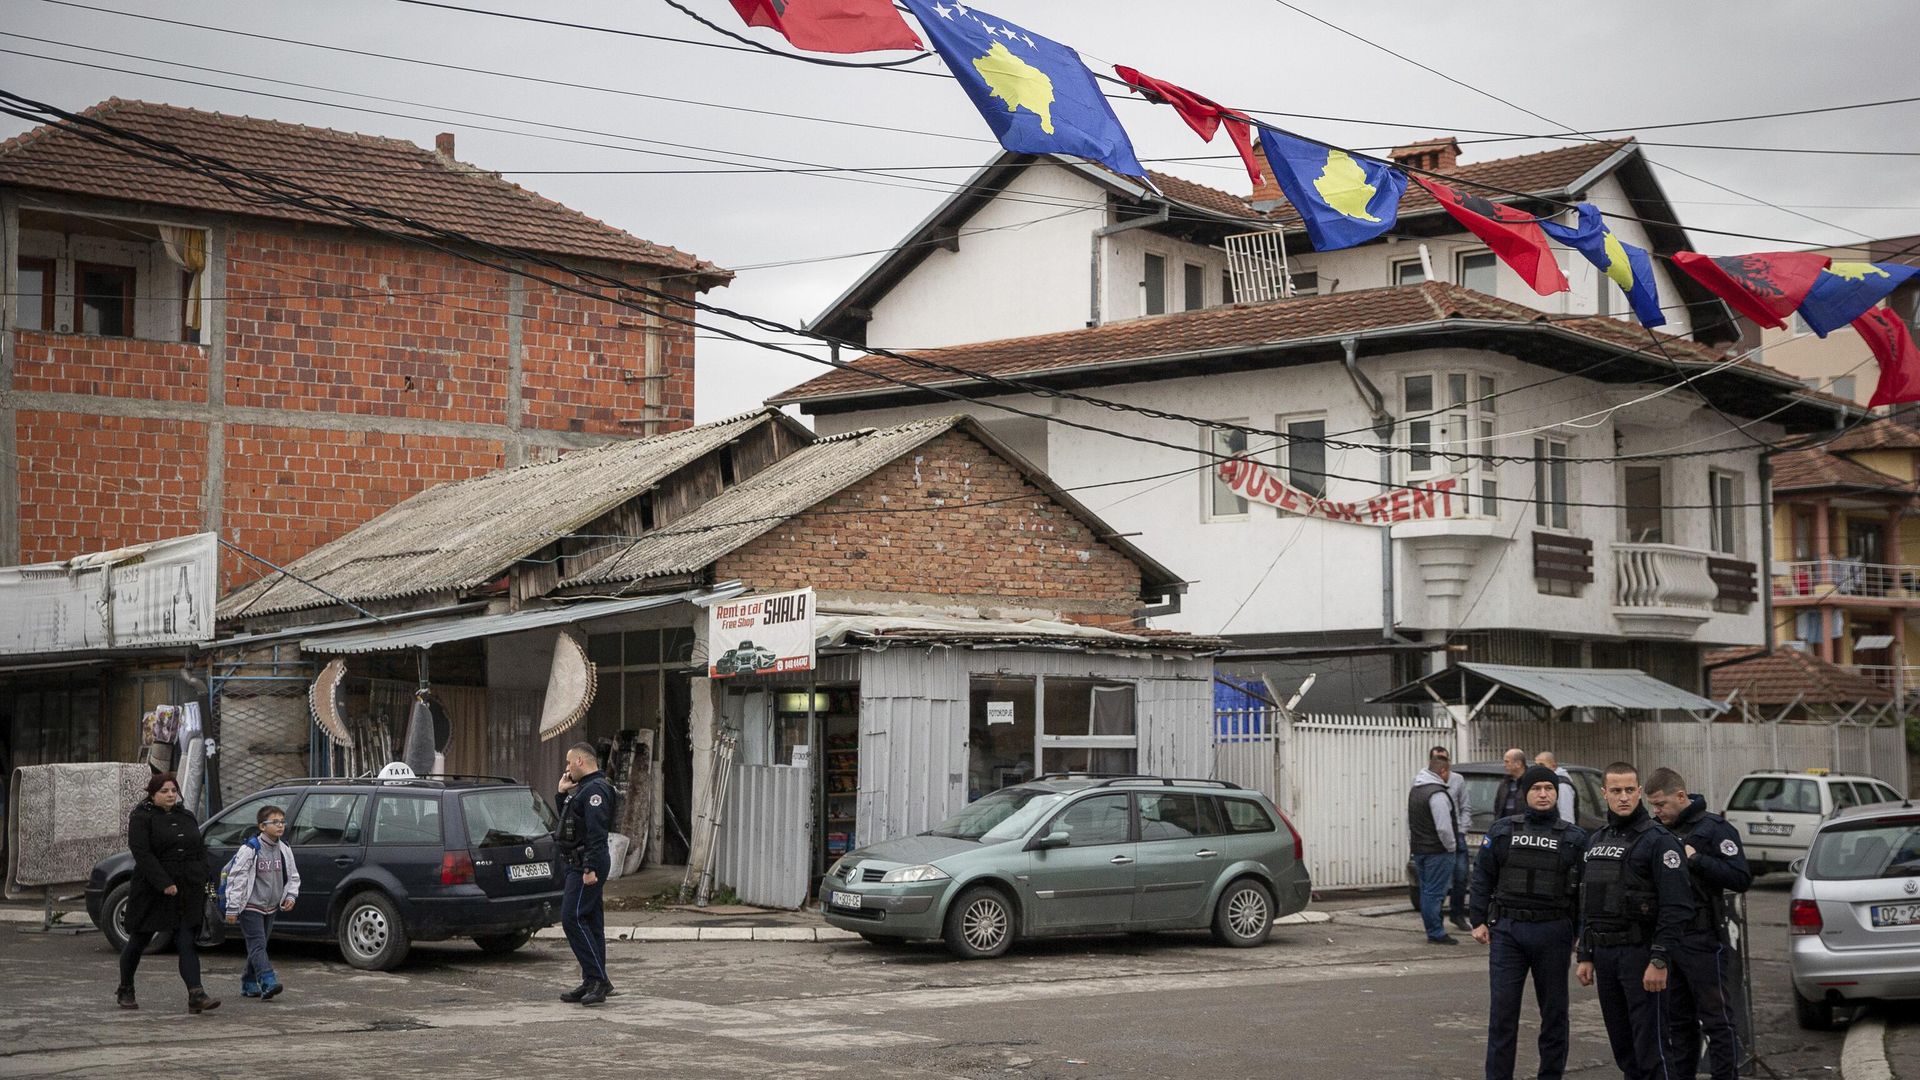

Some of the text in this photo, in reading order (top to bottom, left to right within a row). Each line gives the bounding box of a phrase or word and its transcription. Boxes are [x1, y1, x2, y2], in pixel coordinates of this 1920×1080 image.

[1369, 478, 1456, 523] RENT
[717, 602, 763, 619] Rent a car
[763, 594, 806, 625] SHALA
[722, 617, 755, 629] Free Shop
[1511, 835, 1558, 850] POLICE
[1587, 846, 1625, 858] POLICE
